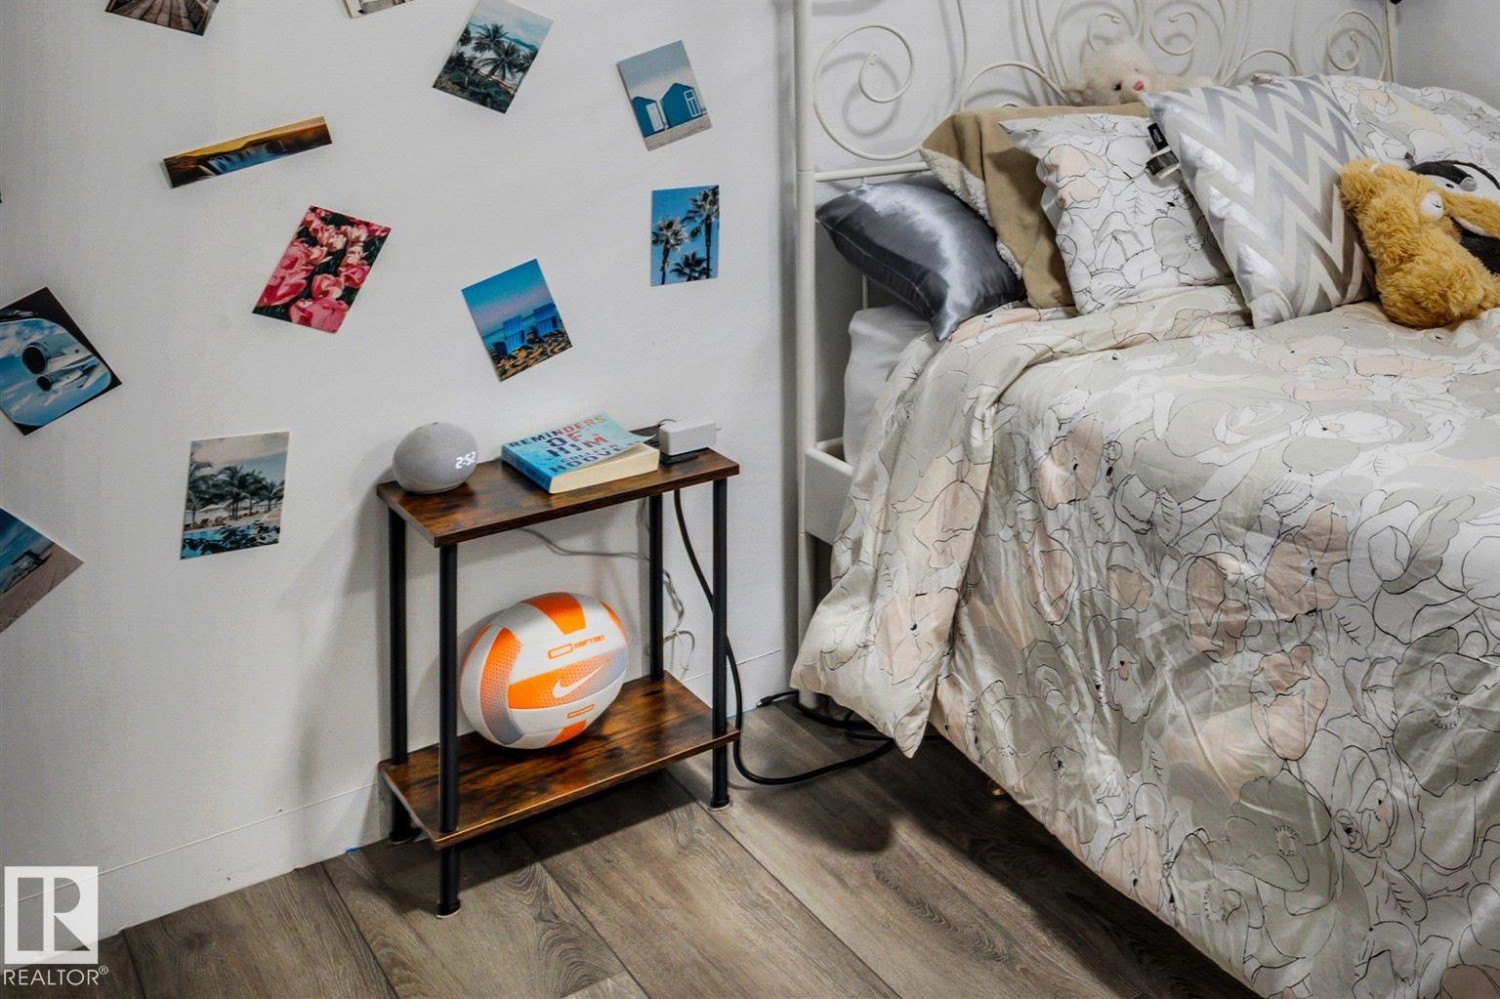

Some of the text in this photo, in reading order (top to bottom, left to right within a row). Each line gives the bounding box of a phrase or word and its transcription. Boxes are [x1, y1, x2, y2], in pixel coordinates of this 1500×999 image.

[509, 415, 606, 448] REMINDERS
[546, 429, 583, 447] OF
[547, 433, 608, 457] HIM
[455, 450, 477, 469] 2:52
[549, 442, 638, 473] HOOVE
